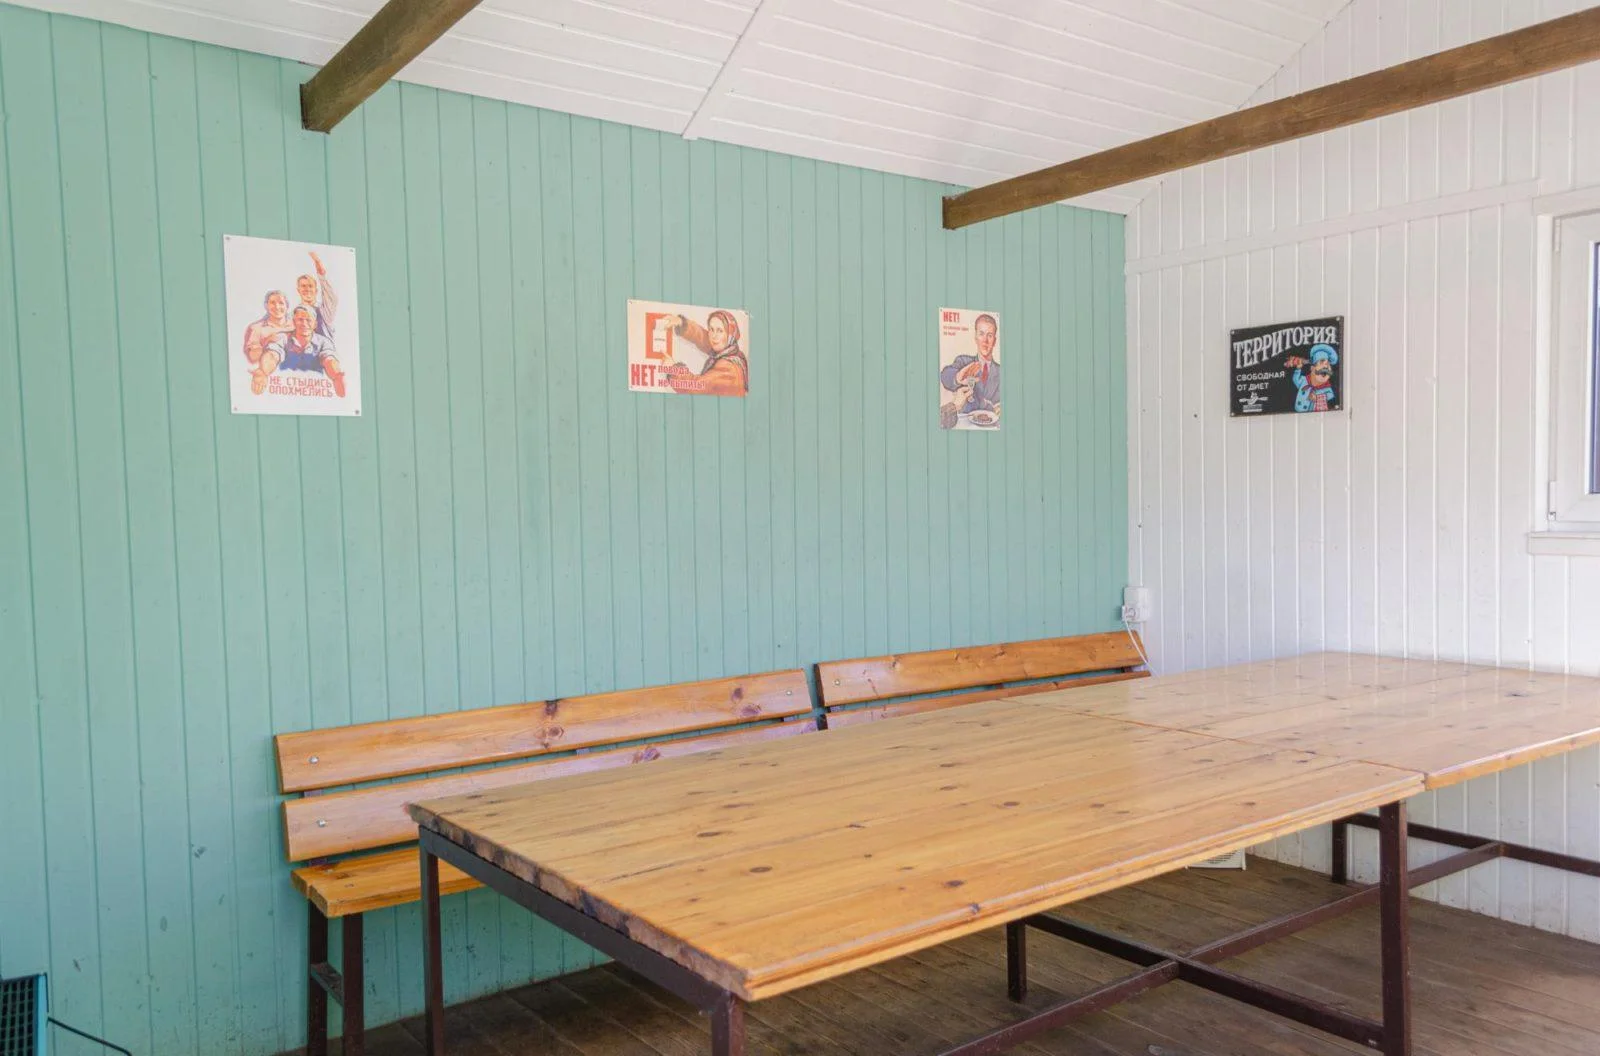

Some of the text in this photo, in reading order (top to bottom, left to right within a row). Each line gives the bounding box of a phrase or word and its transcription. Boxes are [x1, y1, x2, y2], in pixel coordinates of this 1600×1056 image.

[943, 311, 960, 323] НЕТ!
[1233, 326, 1337, 369] ТЕРРИТОРИЯ
[631, 363, 656, 386] НЕТ
[1236, 371, 1285, 381] СВОБОДНАЯ
[269, 375, 332, 388] НЕ СТЫДИСЬ
[1248, 381, 1269, 391] ДИЕТ
[269, 385, 334, 397] ОПОХМЕЛИСЬ
